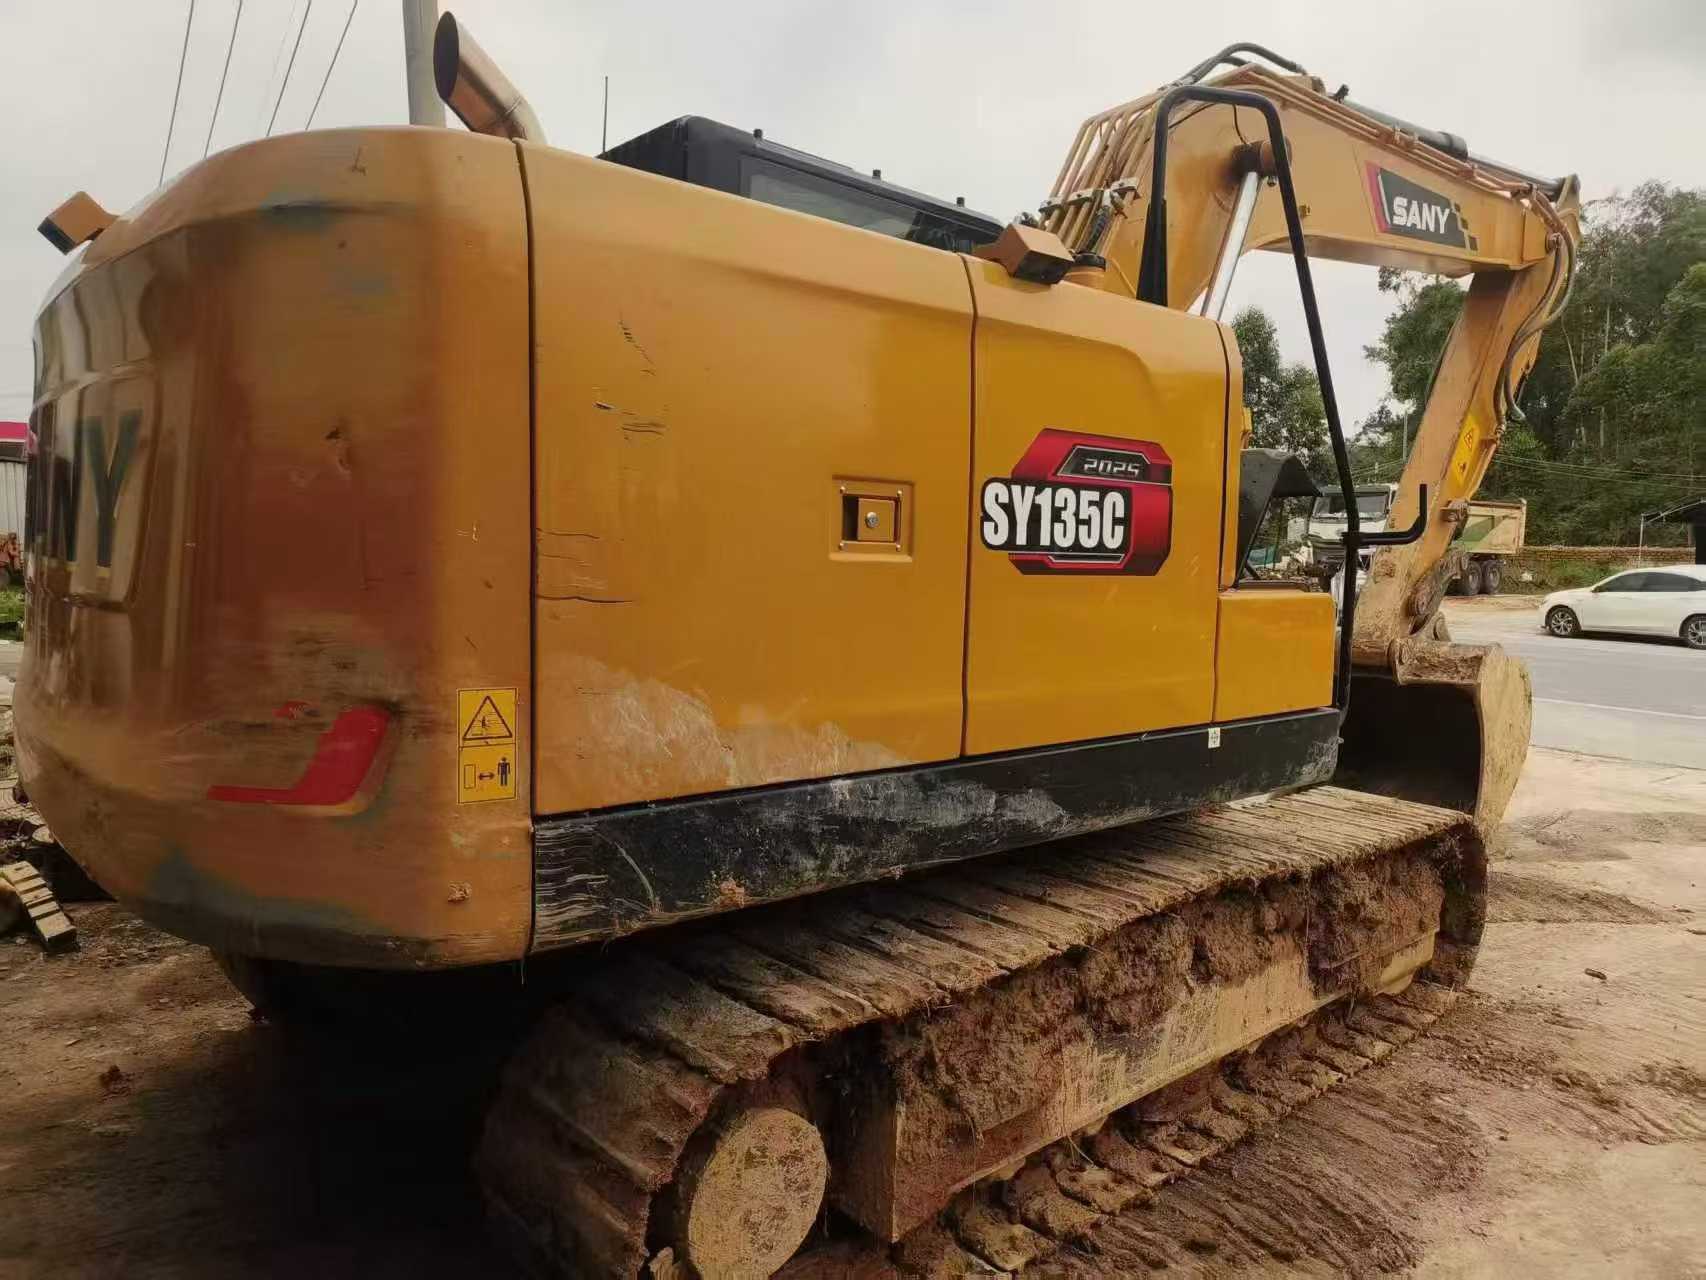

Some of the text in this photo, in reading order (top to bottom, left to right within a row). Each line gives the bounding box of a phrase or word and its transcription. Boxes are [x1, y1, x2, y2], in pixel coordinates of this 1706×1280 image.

[1392, 196, 1450, 234] SANY
[1083, 458, 1141, 478] 2025
[983, 481, 1125, 549] SY135C
